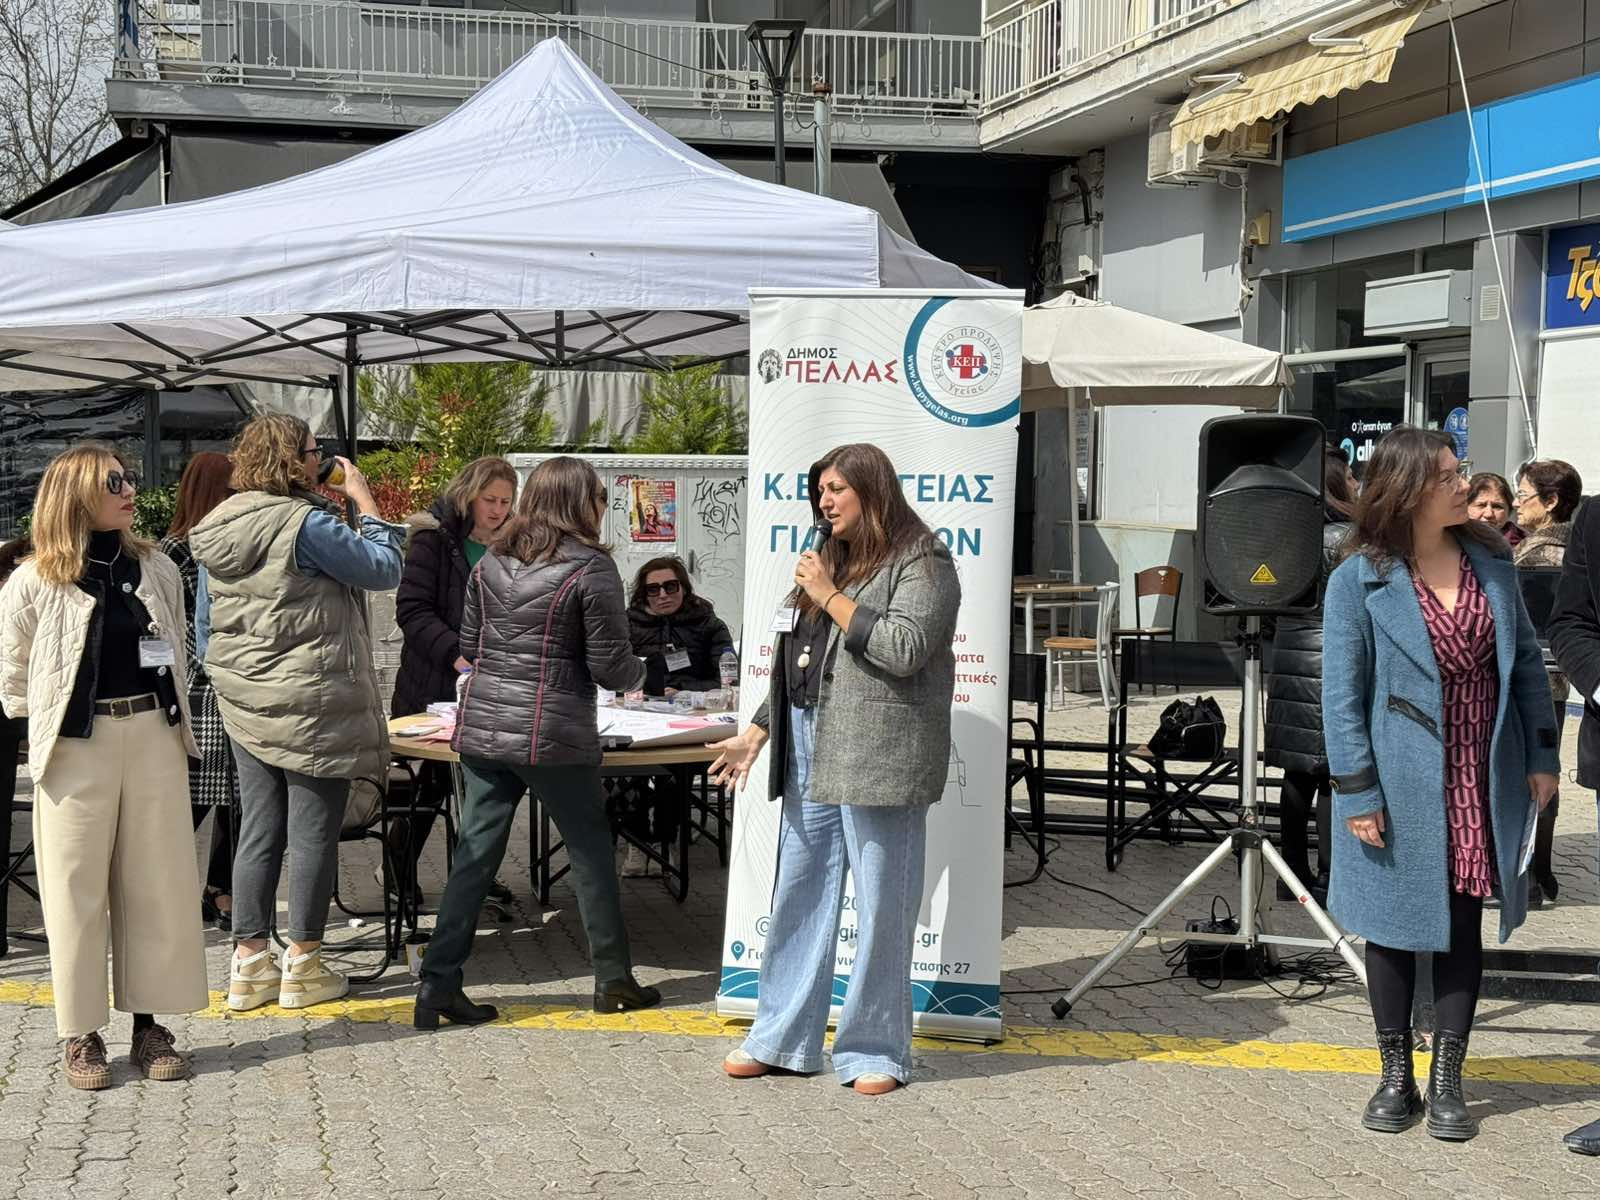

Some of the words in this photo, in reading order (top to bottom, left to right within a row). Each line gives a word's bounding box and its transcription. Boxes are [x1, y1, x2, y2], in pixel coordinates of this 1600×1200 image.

[787, 347, 837, 359] ΔΗΜΟΣ
[953, 356, 981, 367] ΚΕΠ
[785, 359, 898, 384] ΠΕΛΛΑΣ
[896, 473, 994, 503] ΓΕΙΑΣ
[912, 961, 951, 976] τασης
[954, 962, 971, 974] 27
